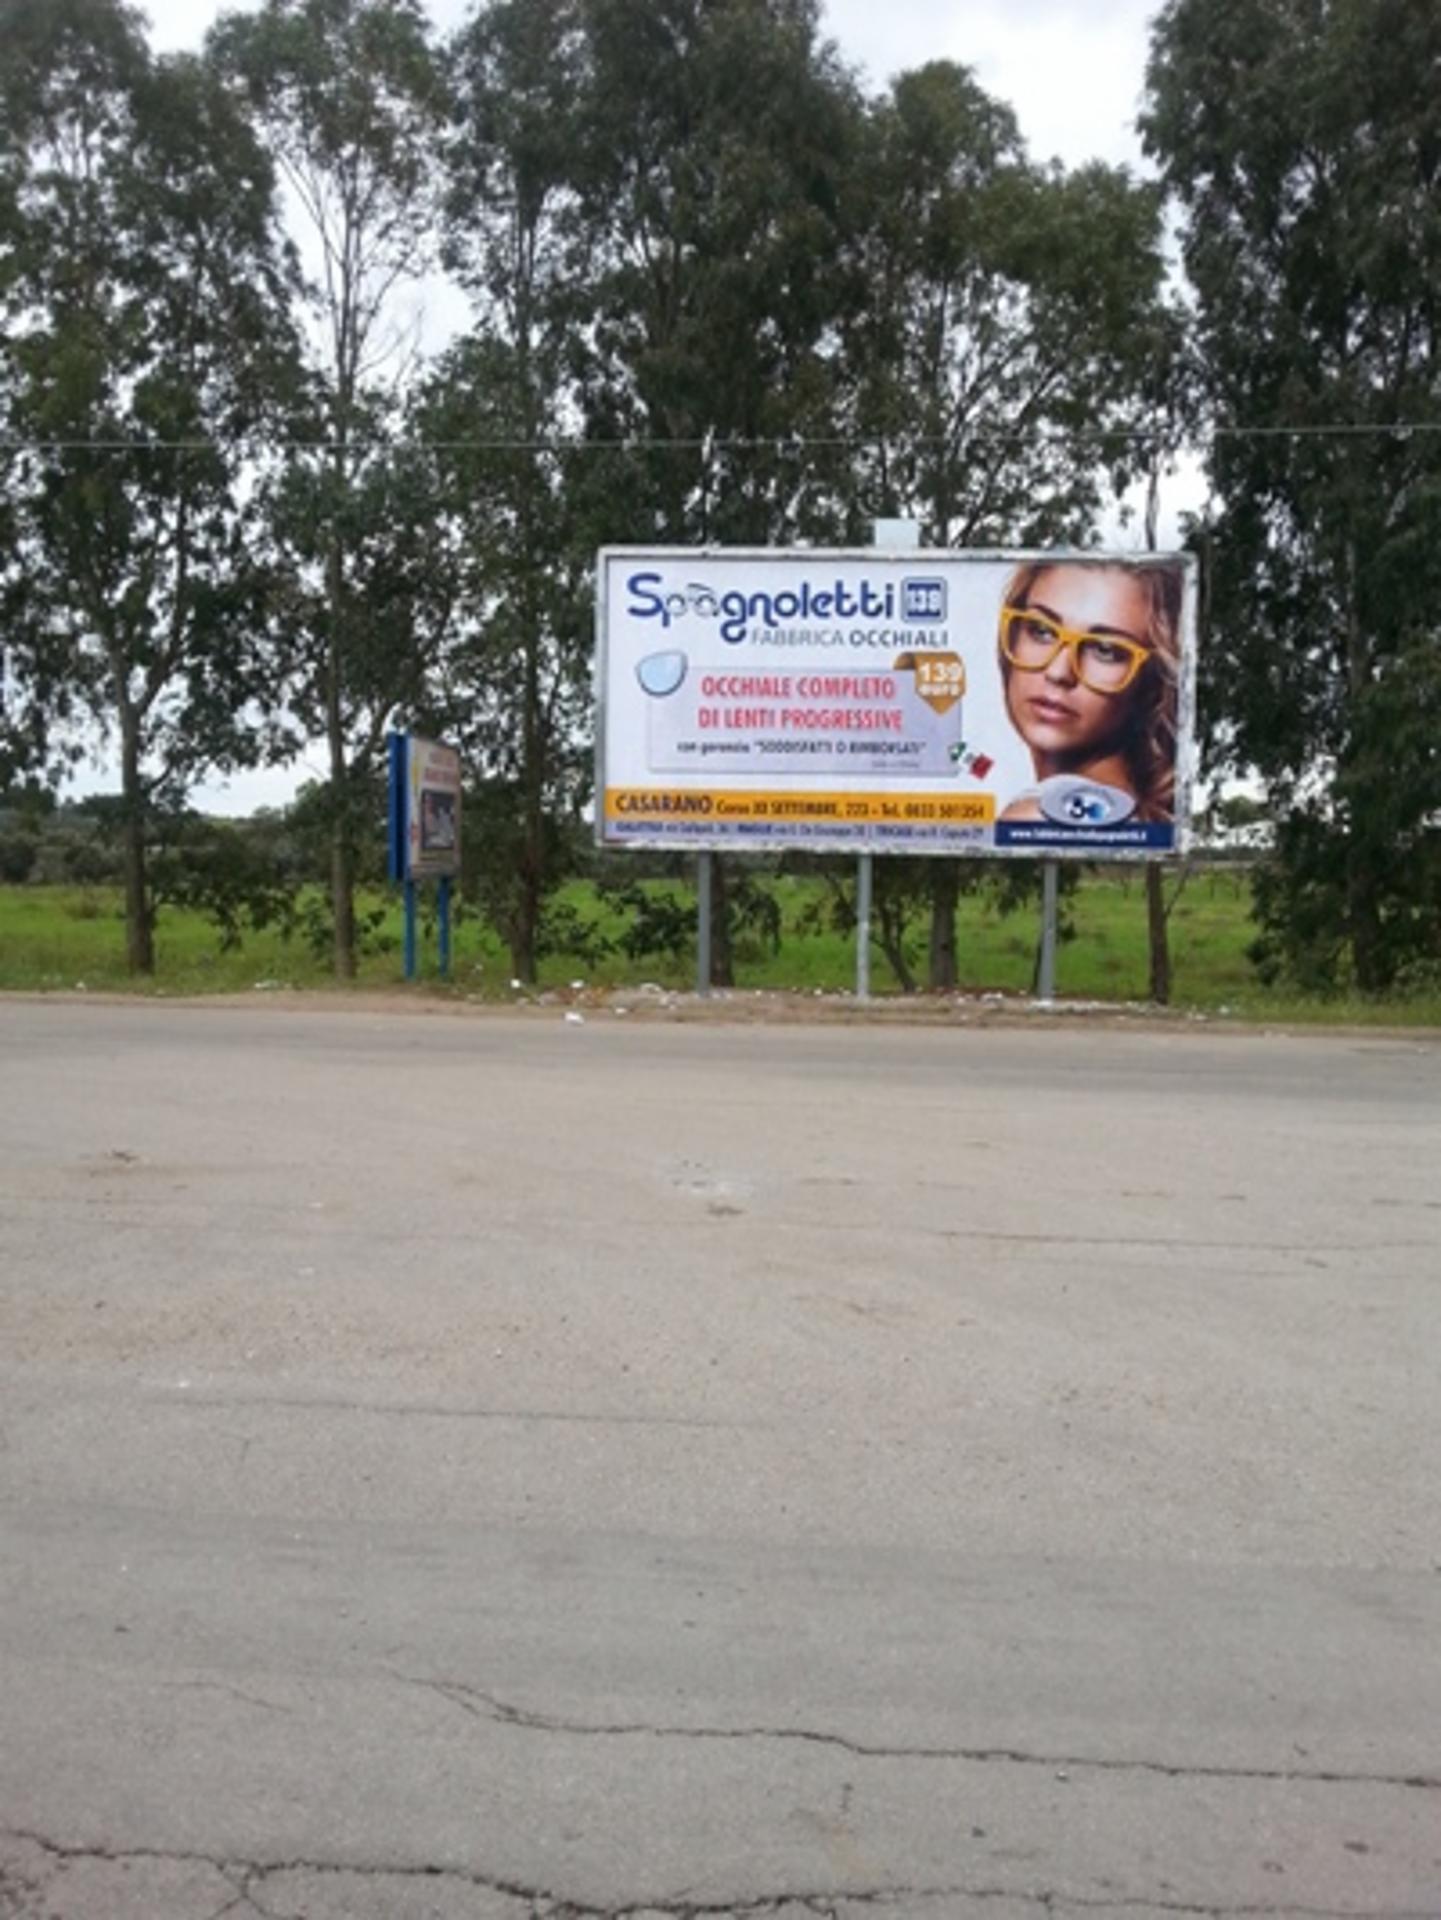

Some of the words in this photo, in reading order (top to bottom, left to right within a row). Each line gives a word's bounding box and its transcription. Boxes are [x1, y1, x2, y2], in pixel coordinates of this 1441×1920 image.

[626, 572, 893, 644] Spagnoletti
[849, 629, 949, 648] OCCHIALI
[701, 676, 791, 699] OCCHIALE
[797, 677, 895, 700] COMPLETO
[698, 708, 719, 730] DI
[724, 708, 777, 730] LENTI
[780, 708, 904, 733] PROGRESSIVE
[615, 795, 713, 814] CASARANO
